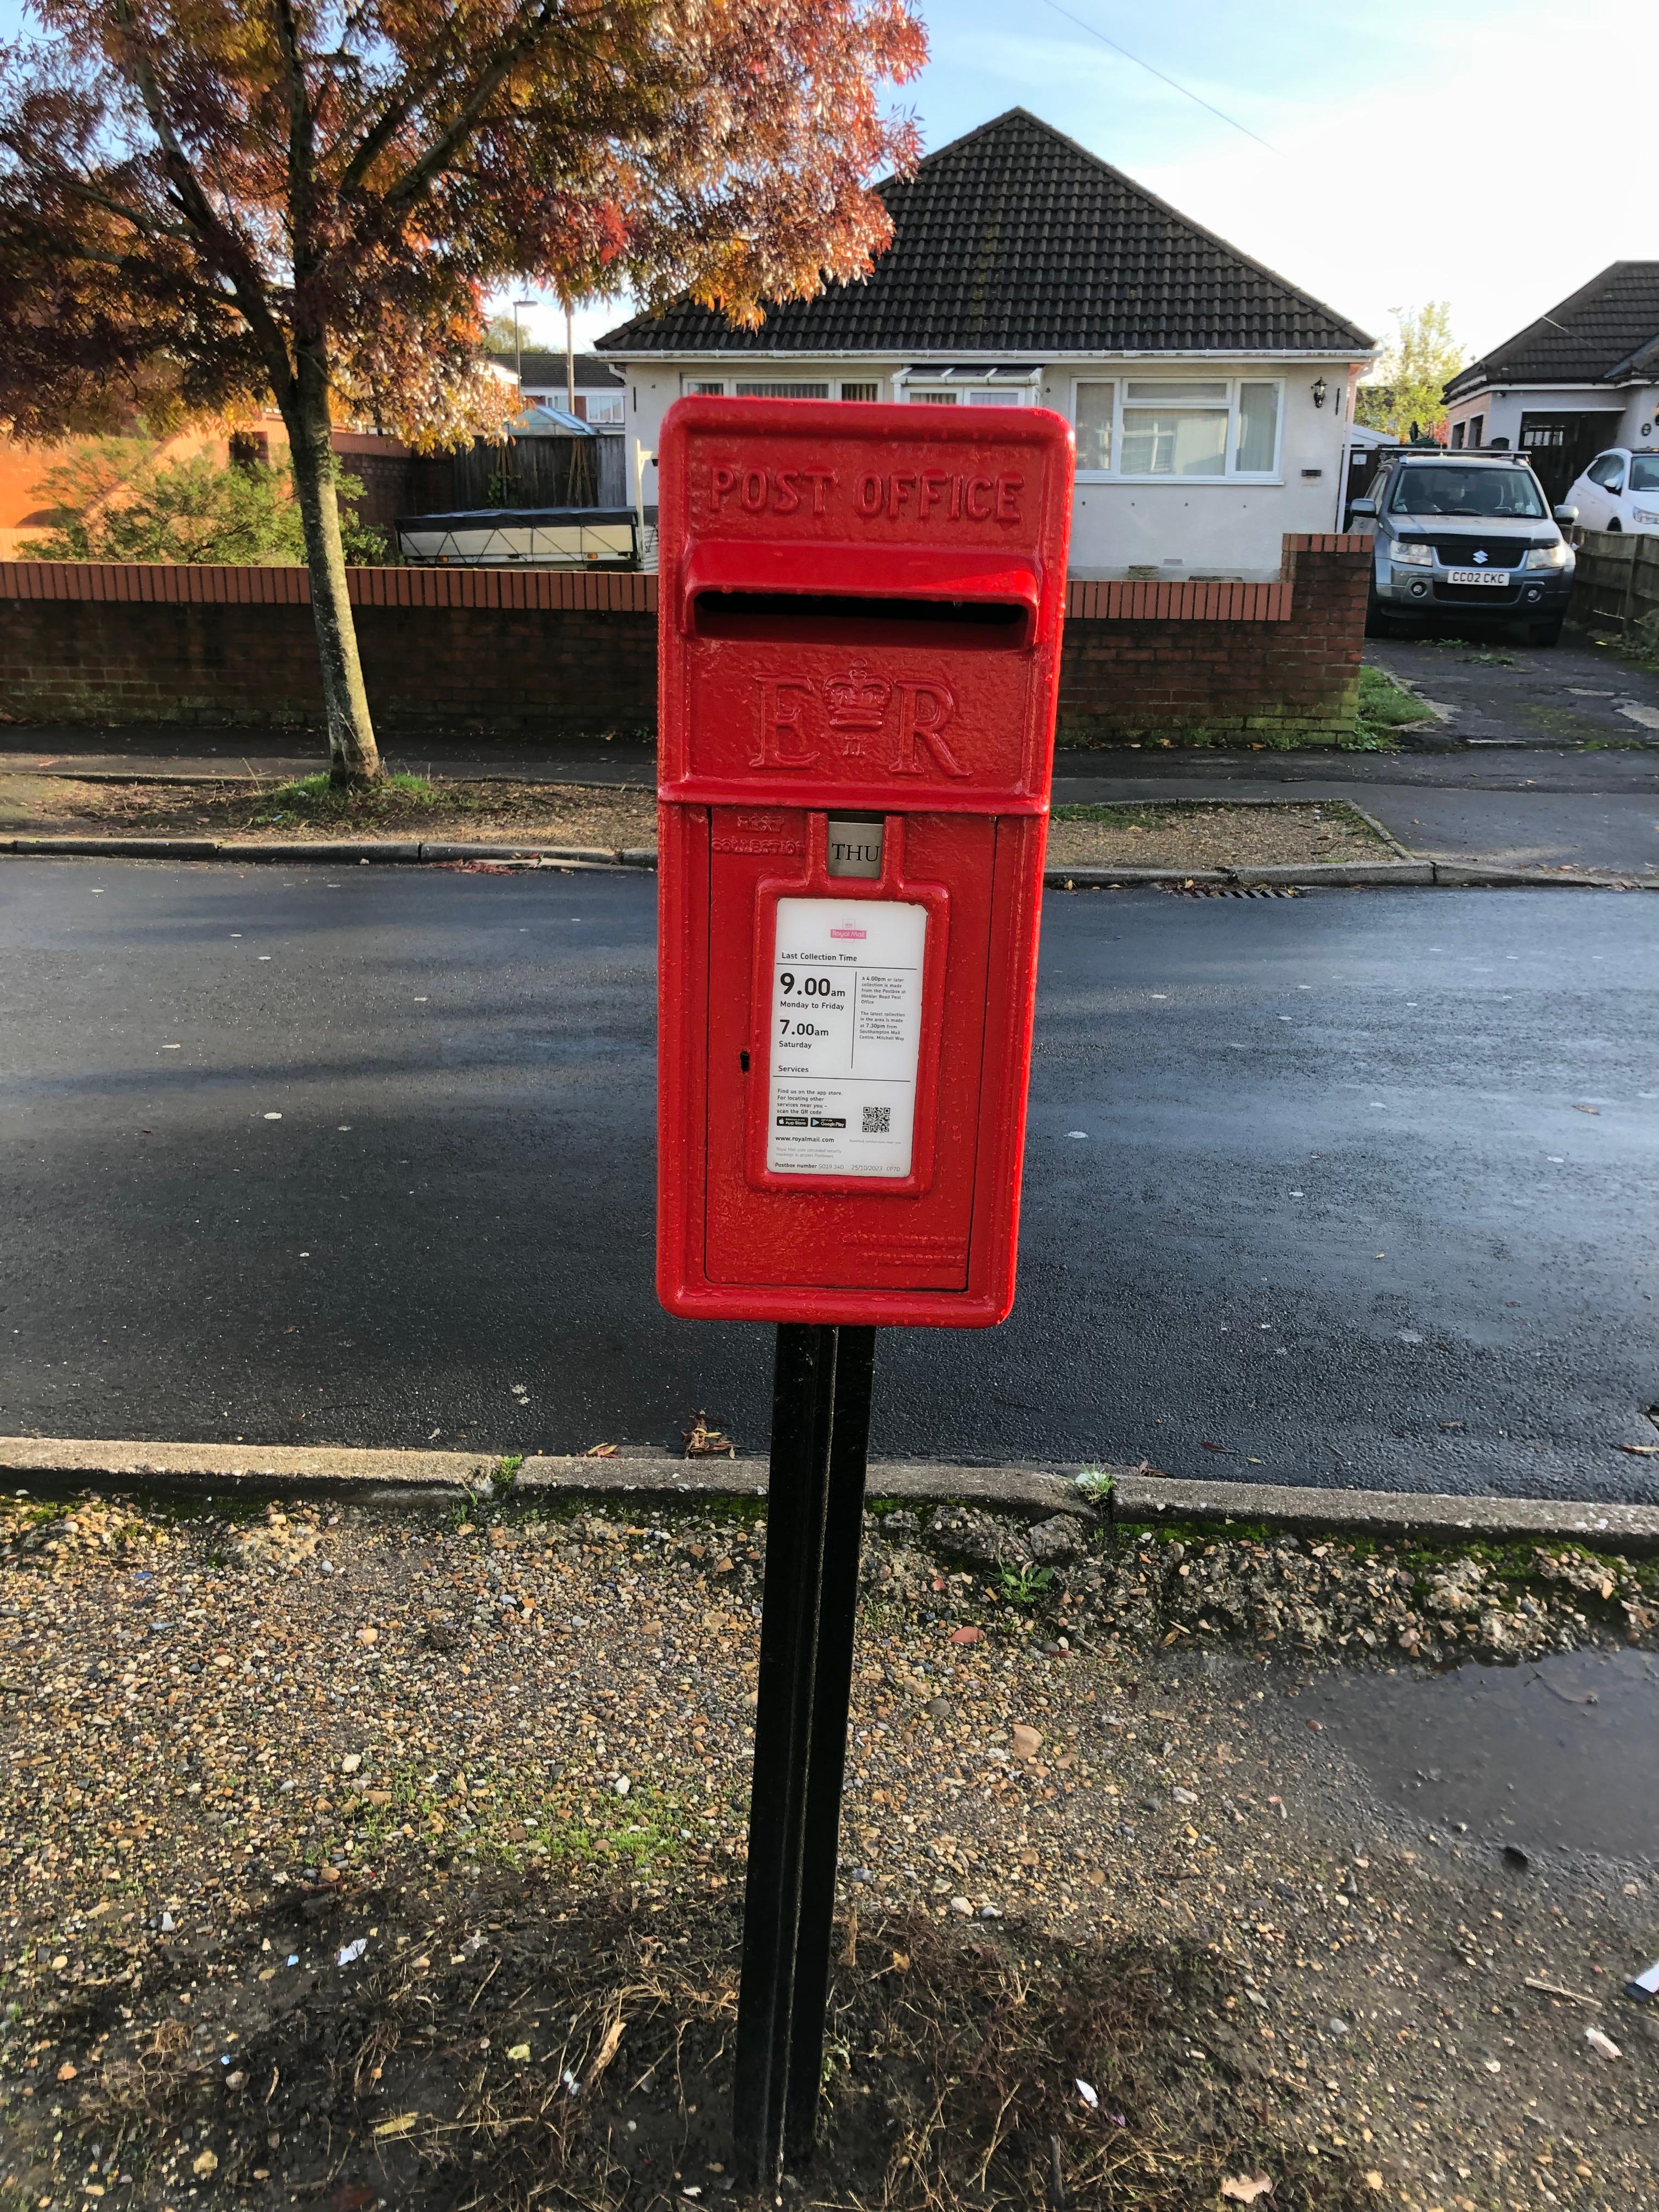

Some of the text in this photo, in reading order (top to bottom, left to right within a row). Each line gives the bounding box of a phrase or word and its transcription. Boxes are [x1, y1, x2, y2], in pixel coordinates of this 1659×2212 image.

[710, 465, 1025, 523] POST OFFICE
[1453, 572, 1504, 583] CC02 CKC
[832, 843, 880, 862] THU
[800, 952, 837, 961] Collection
[780, 973, 845, 997] 9.00am
[780, 1001, 809, 1009] Monday
[822, 1002, 844, 1011] Friday
[780, 1019, 828, 1036] 7.00am
[779, 1041, 812, 1049] Saturday
